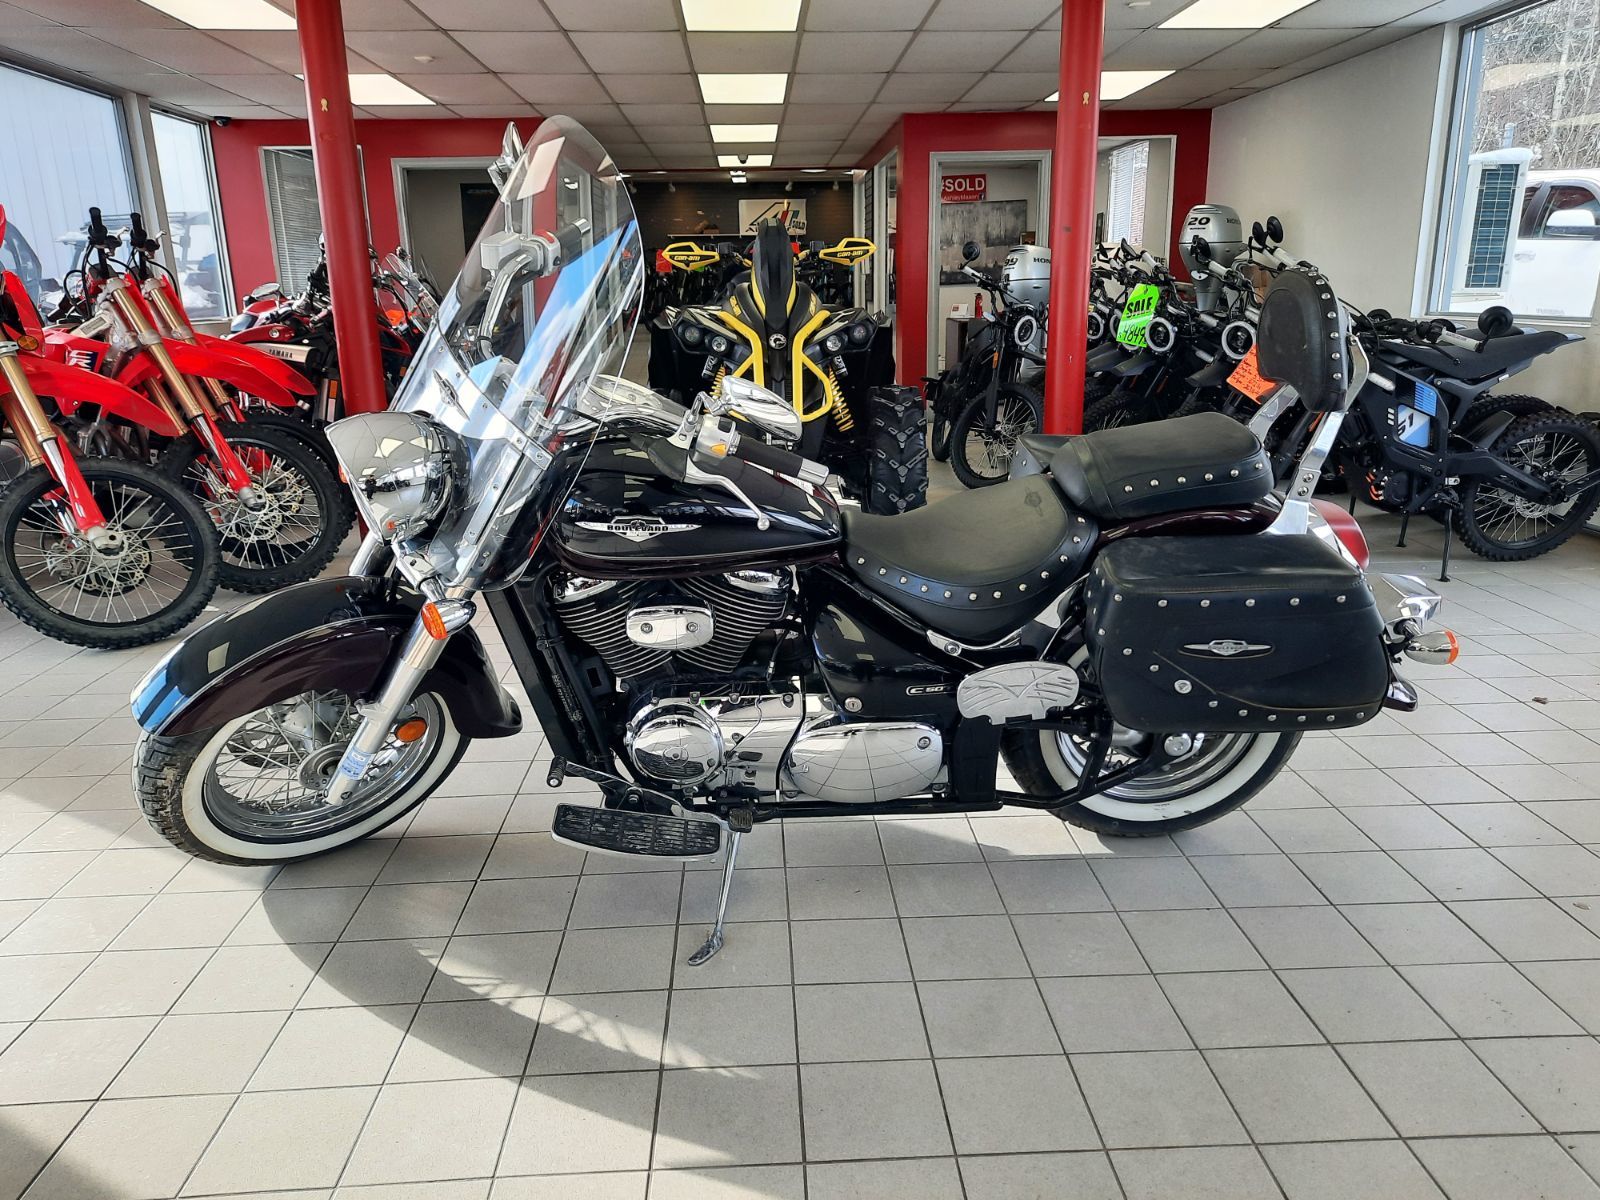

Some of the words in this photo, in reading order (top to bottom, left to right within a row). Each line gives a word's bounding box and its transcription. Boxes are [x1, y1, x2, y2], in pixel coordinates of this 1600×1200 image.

[1187, 216, 1211, 226] 20
[1126, 297, 1153, 319] SALE
[269, 348, 293, 359] YAMAHA
[606, 524, 669, 532] BOULEVARD
